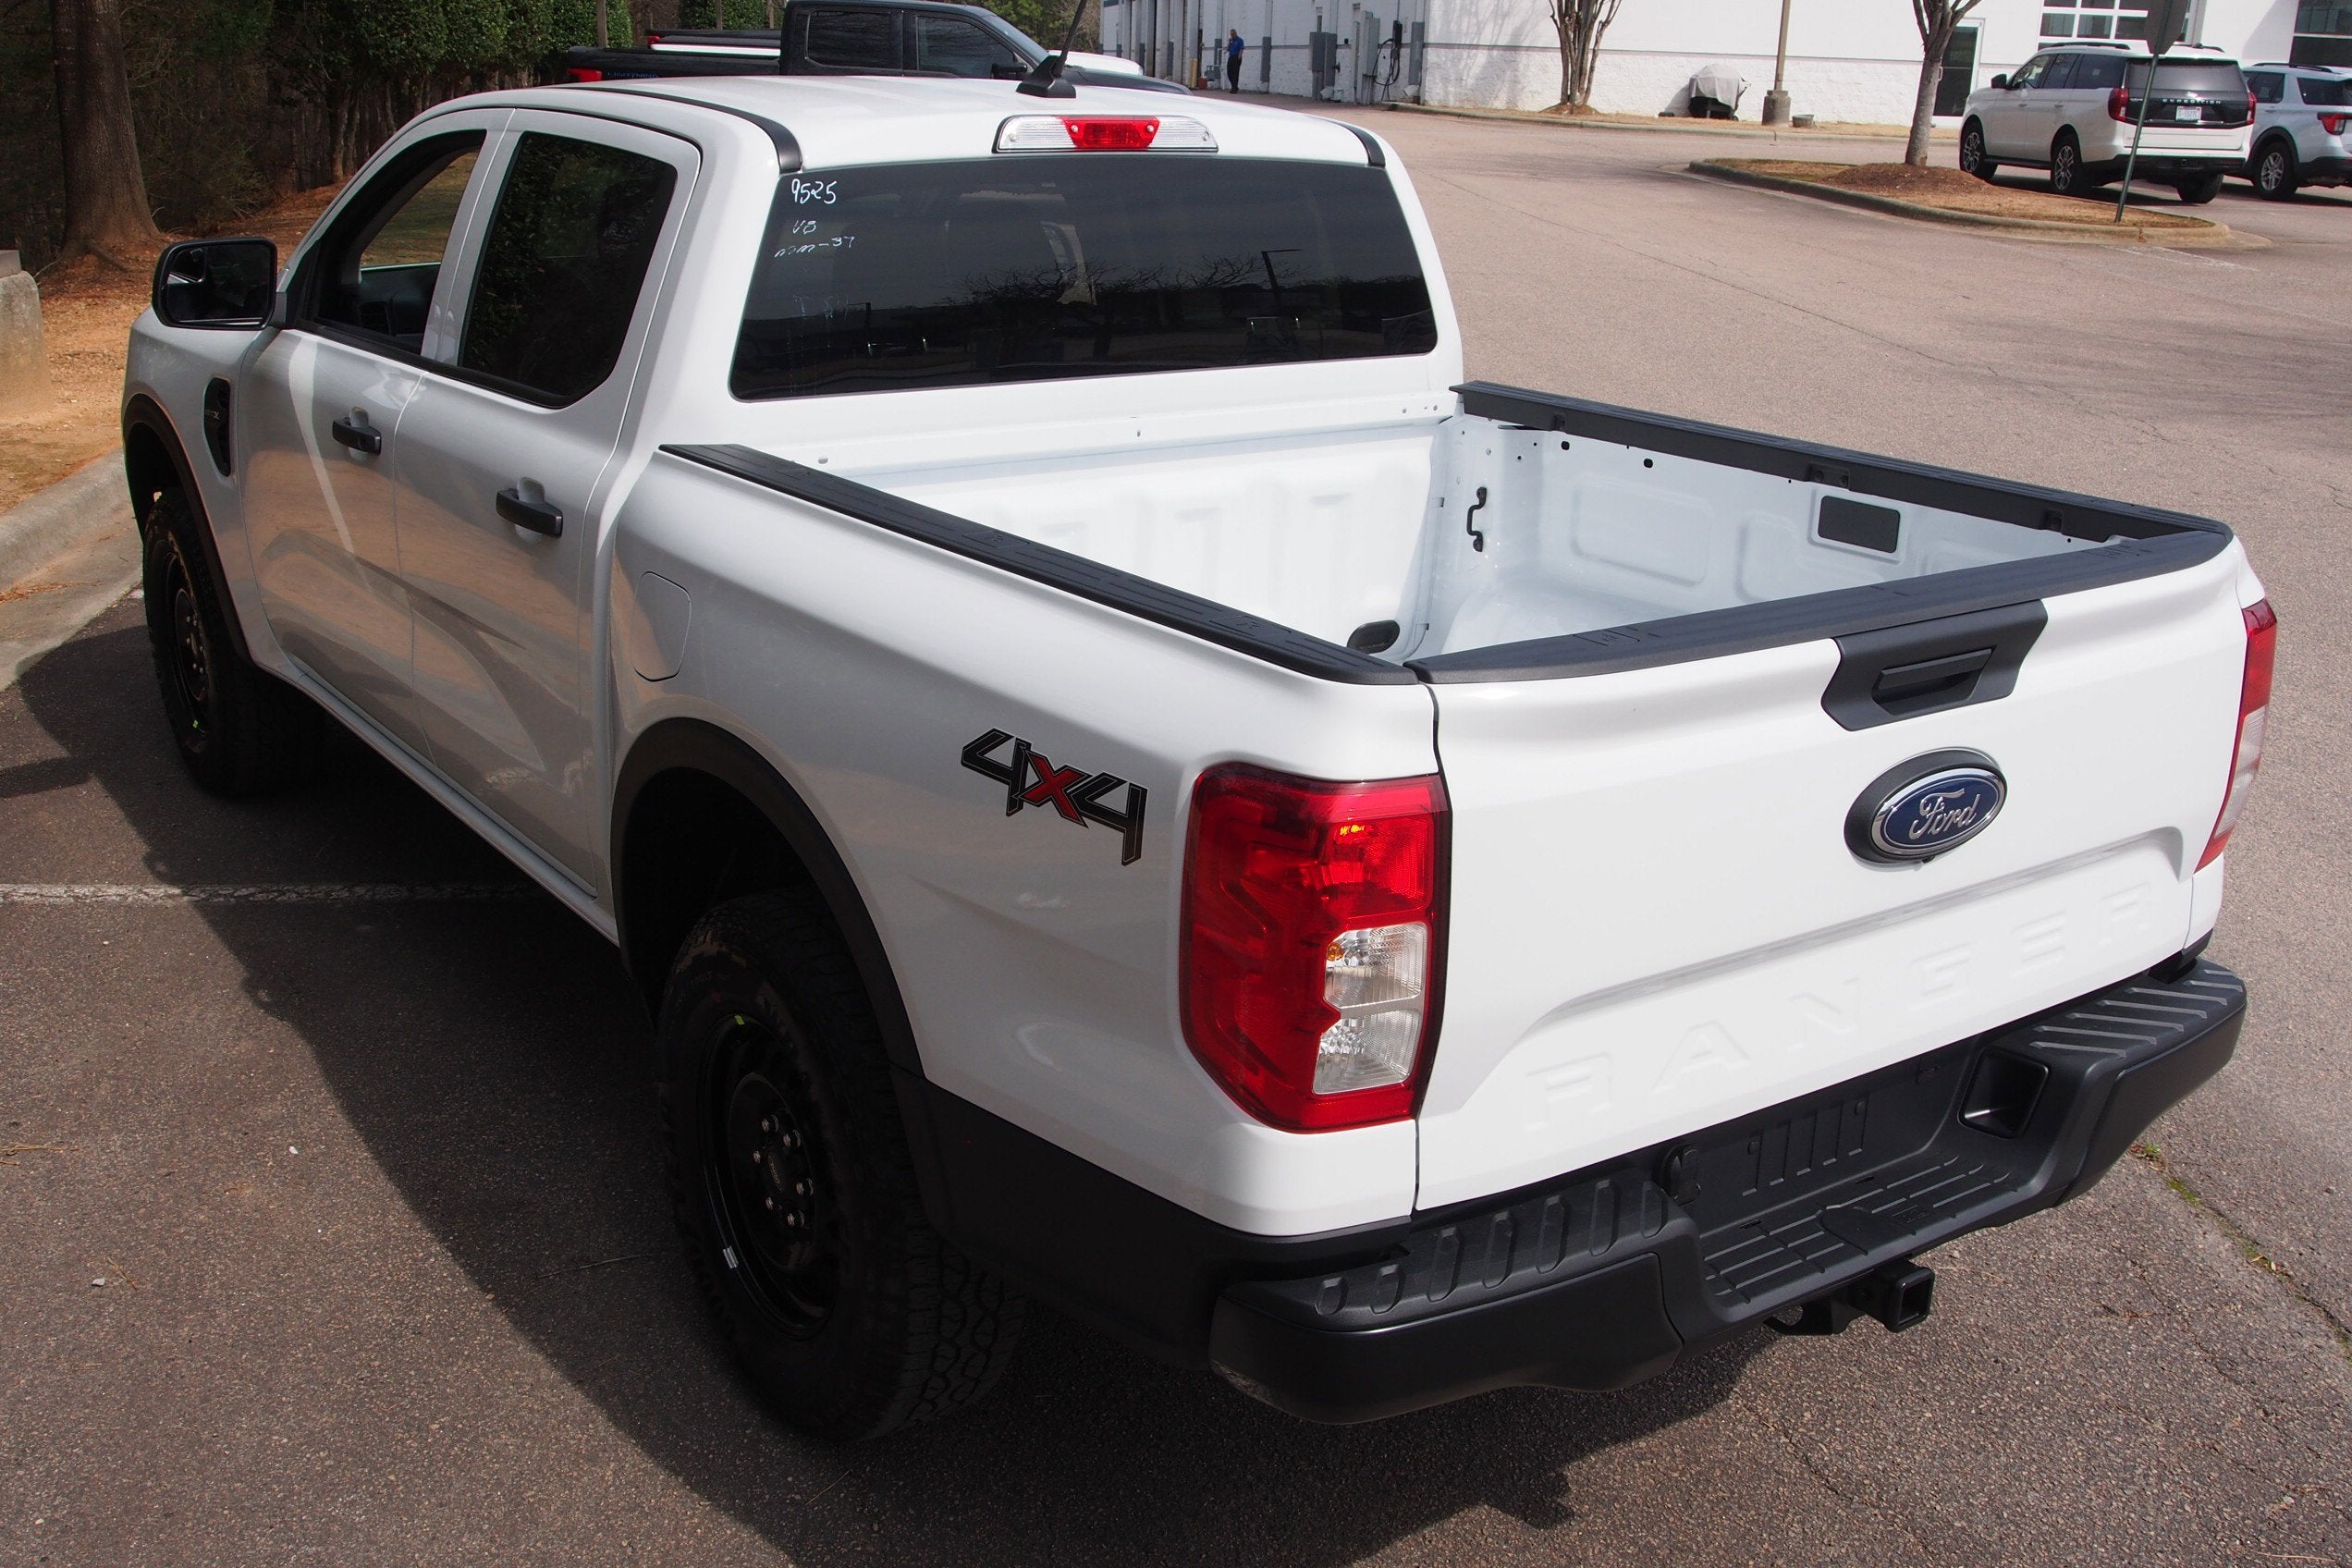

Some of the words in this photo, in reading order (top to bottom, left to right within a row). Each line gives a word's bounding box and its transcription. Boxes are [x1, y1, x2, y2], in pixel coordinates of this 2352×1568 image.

[791, 178, 838, 204] 9525
[1908, 788, 1981, 841] Ford
[1523, 881, 2153, 1133] RANGER
